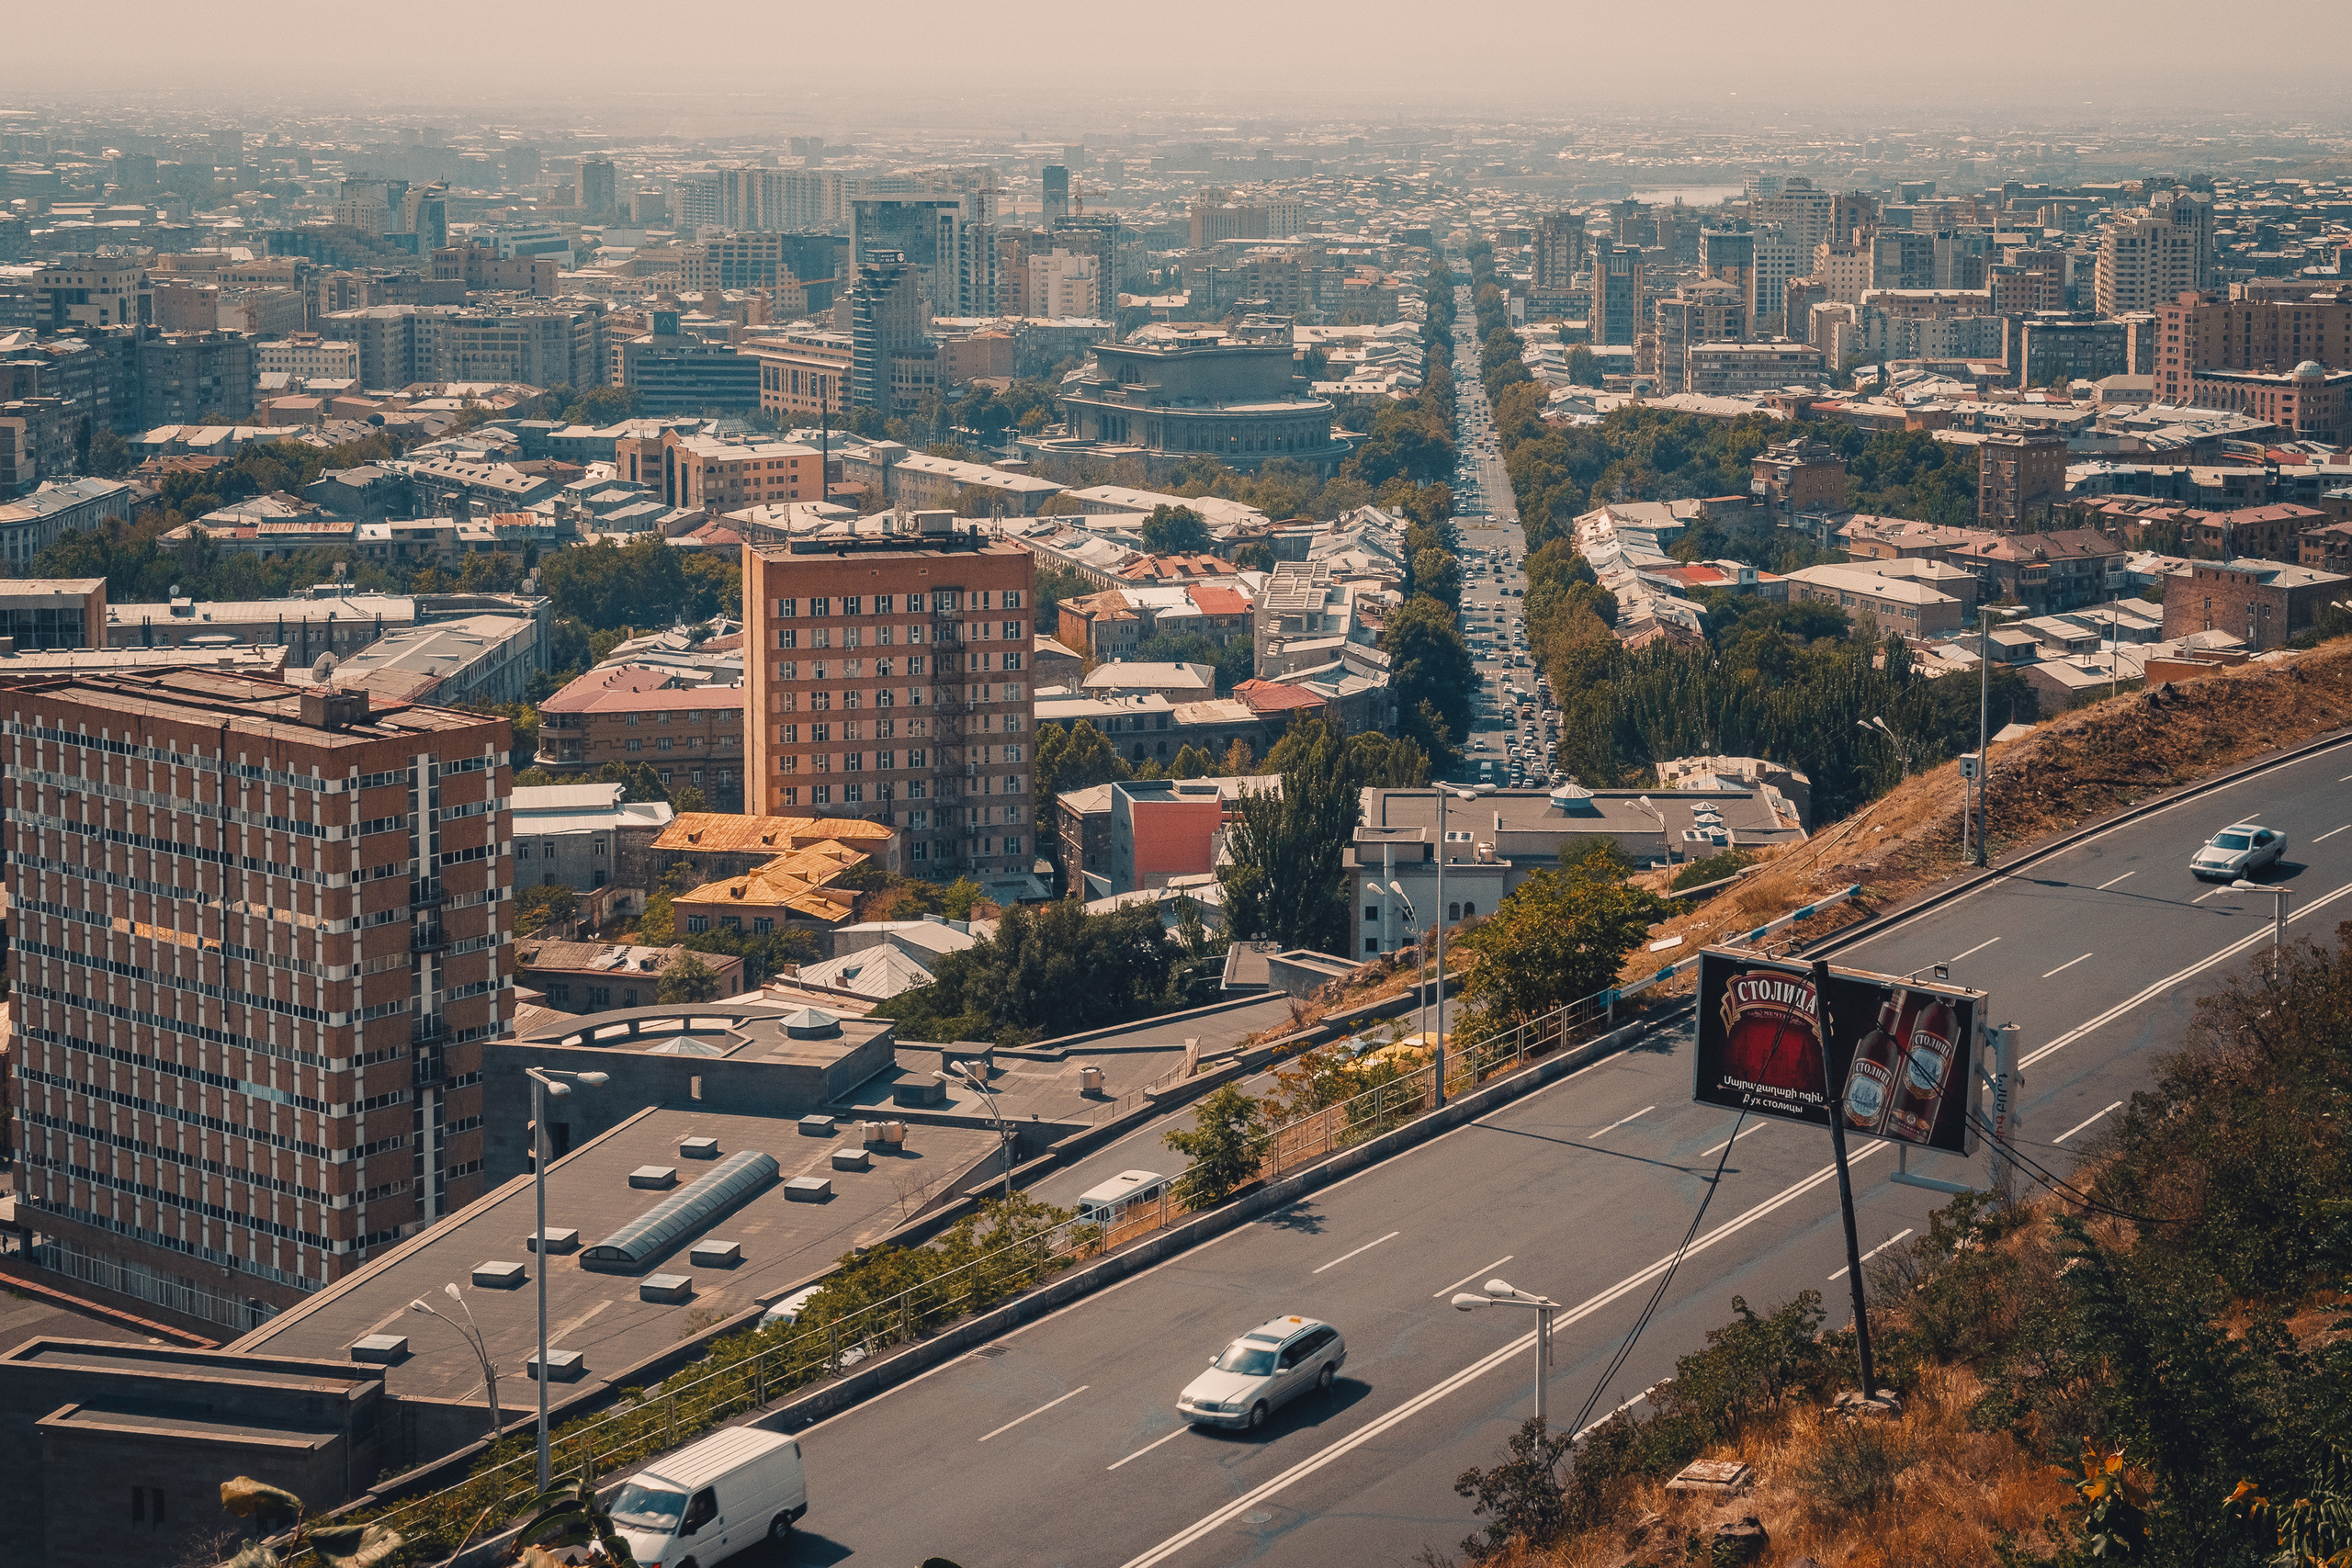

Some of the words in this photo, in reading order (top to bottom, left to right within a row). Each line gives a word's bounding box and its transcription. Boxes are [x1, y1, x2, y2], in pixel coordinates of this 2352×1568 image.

[1737, 979, 1816, 1015] СТОЛИЦА
[1915, 1033, 1951, 1058] СТОЛИЦА
[1855, 1062, 1891, 1086] СТОЛИЦА
[1724, 1075, 1797, 1100] Մայրաքաղաքի
[1799, 1091, 1824, 1103] ոգին
[1742, 1093, 1761, 1106] Дух
[1762, 1099, 1803, 1113] столицы
